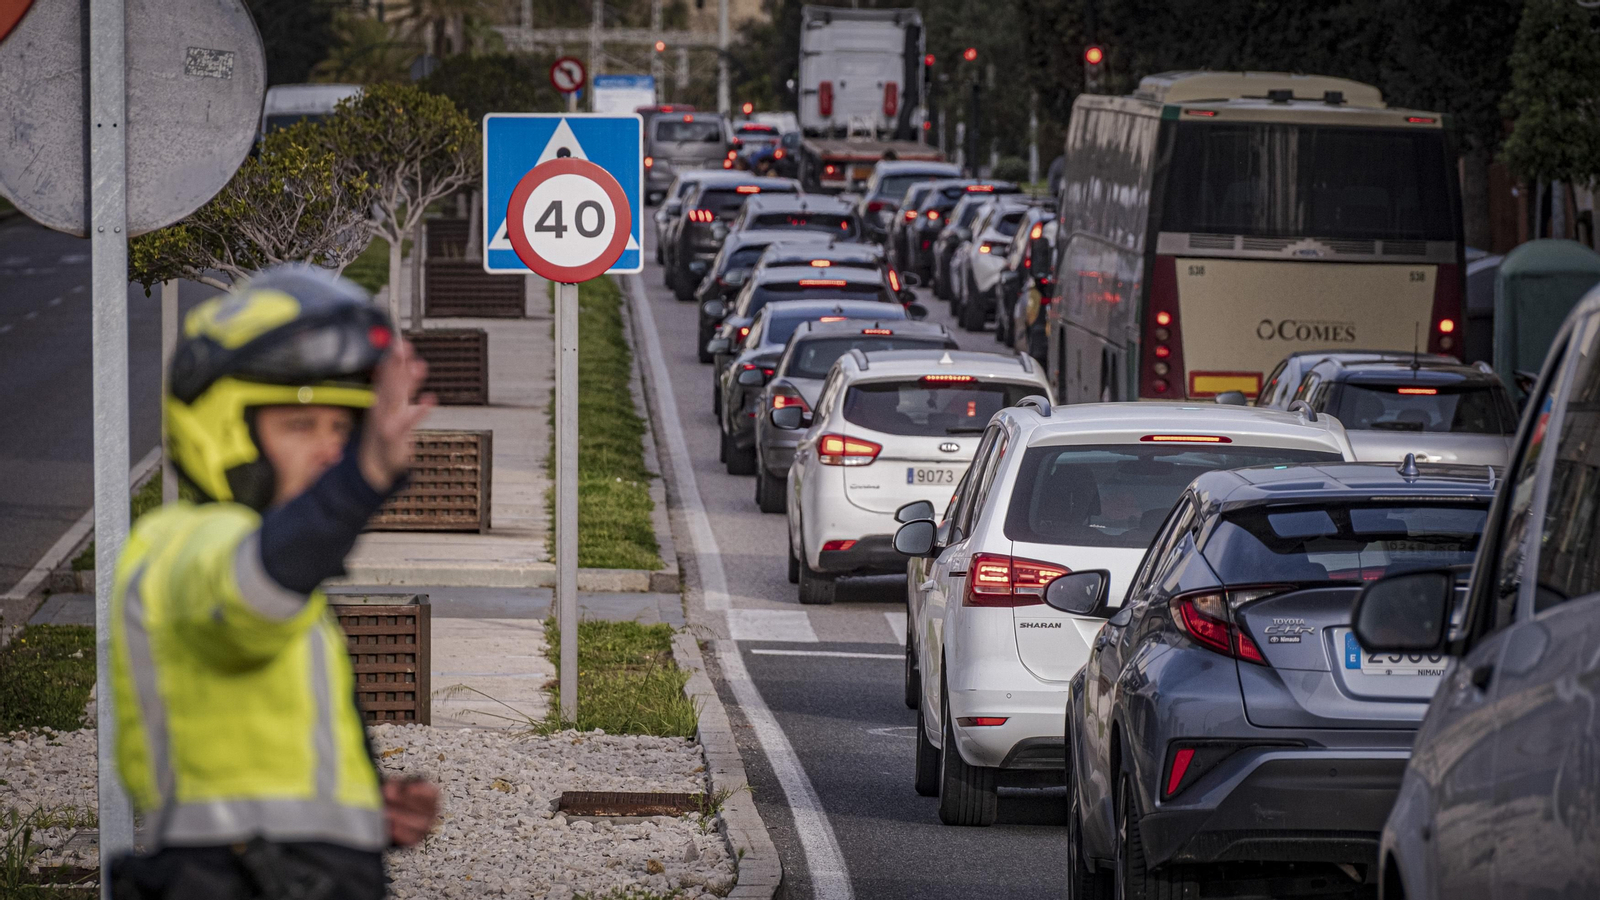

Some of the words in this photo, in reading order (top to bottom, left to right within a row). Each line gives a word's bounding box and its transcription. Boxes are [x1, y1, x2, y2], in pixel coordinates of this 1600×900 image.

[535, 200, 605, 238] 40
[940, 443, 959, 451] KIA
[917, 469, 953, 482] 9073
[1273, 618, 1305, 626] TOYOTA
[1264, 625, 1315, 635] C-HR
